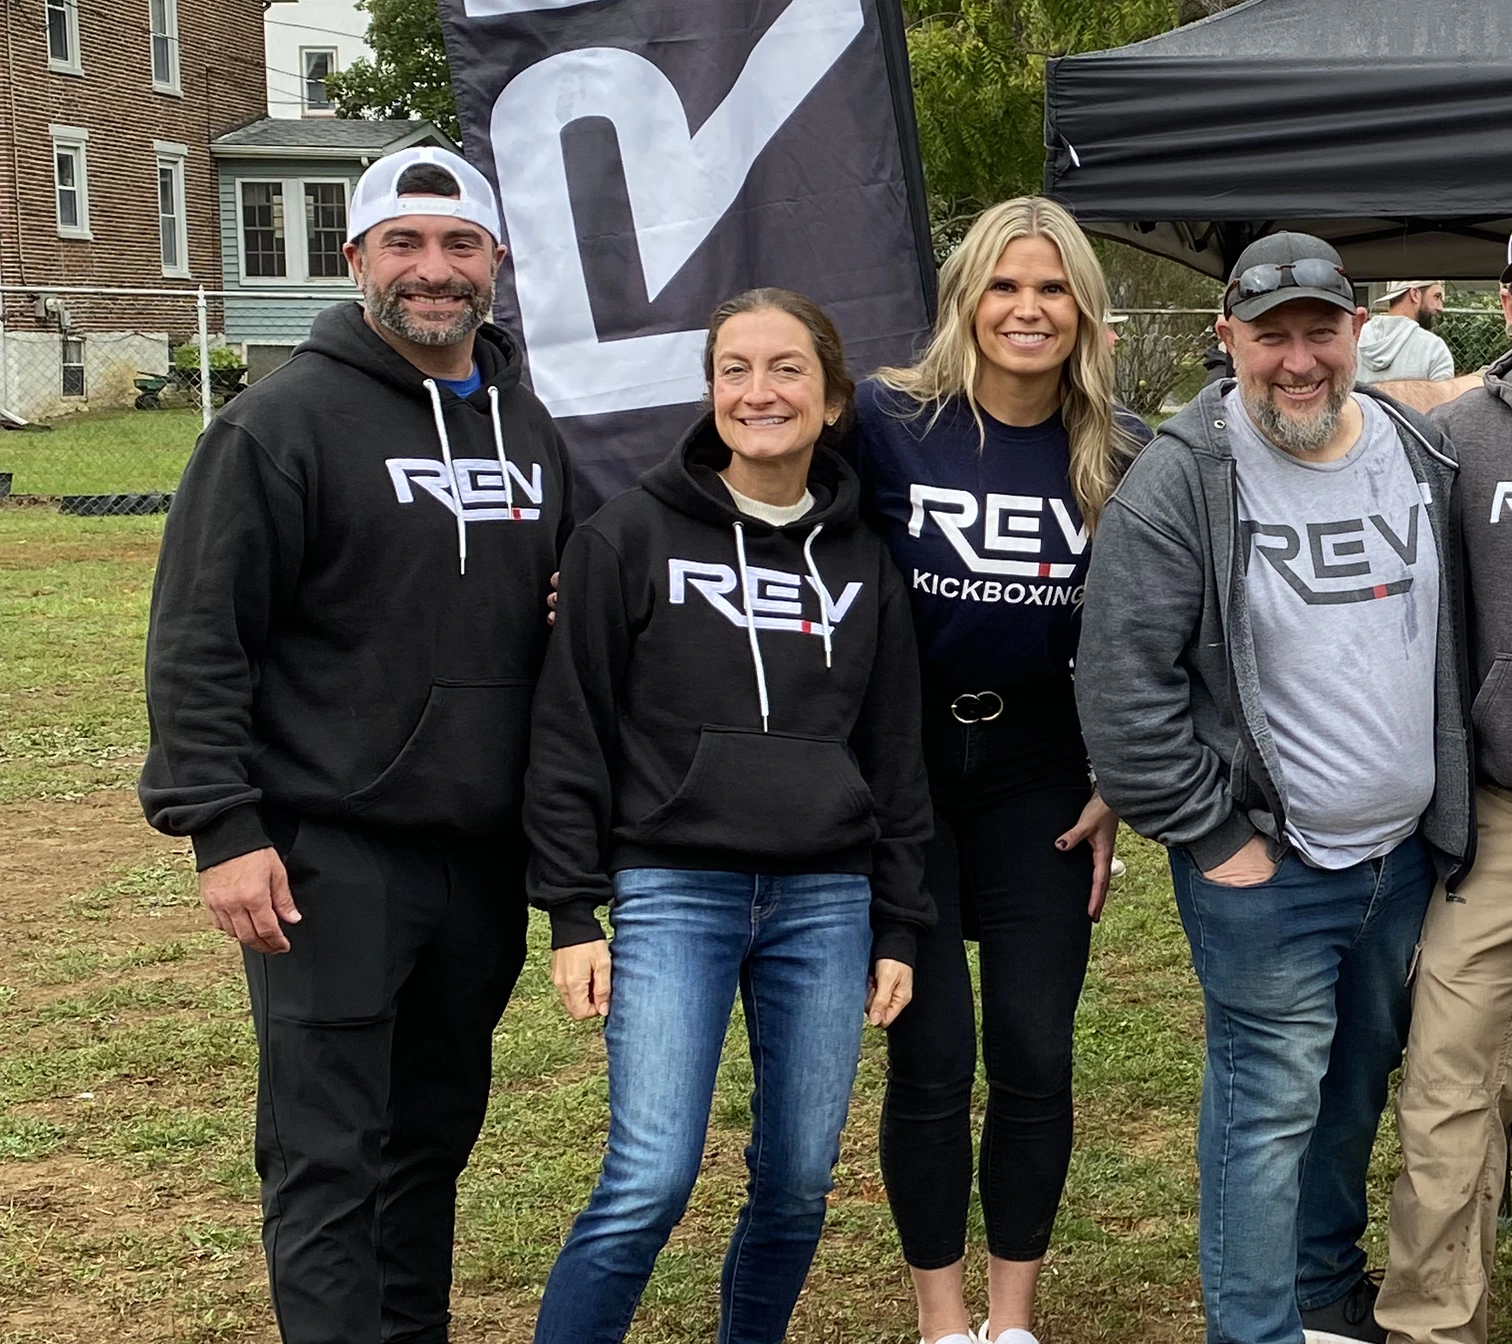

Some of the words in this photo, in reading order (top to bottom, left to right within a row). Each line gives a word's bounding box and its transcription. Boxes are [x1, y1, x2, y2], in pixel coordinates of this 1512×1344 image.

[384, 458, 543, 521] REV
[908, 483, 1092, 578] REV
[1239, 503, 1420, 605] REV
[668, 558, 864, 636] REV
[912, 568, 1086, 606] KICKBOXING
